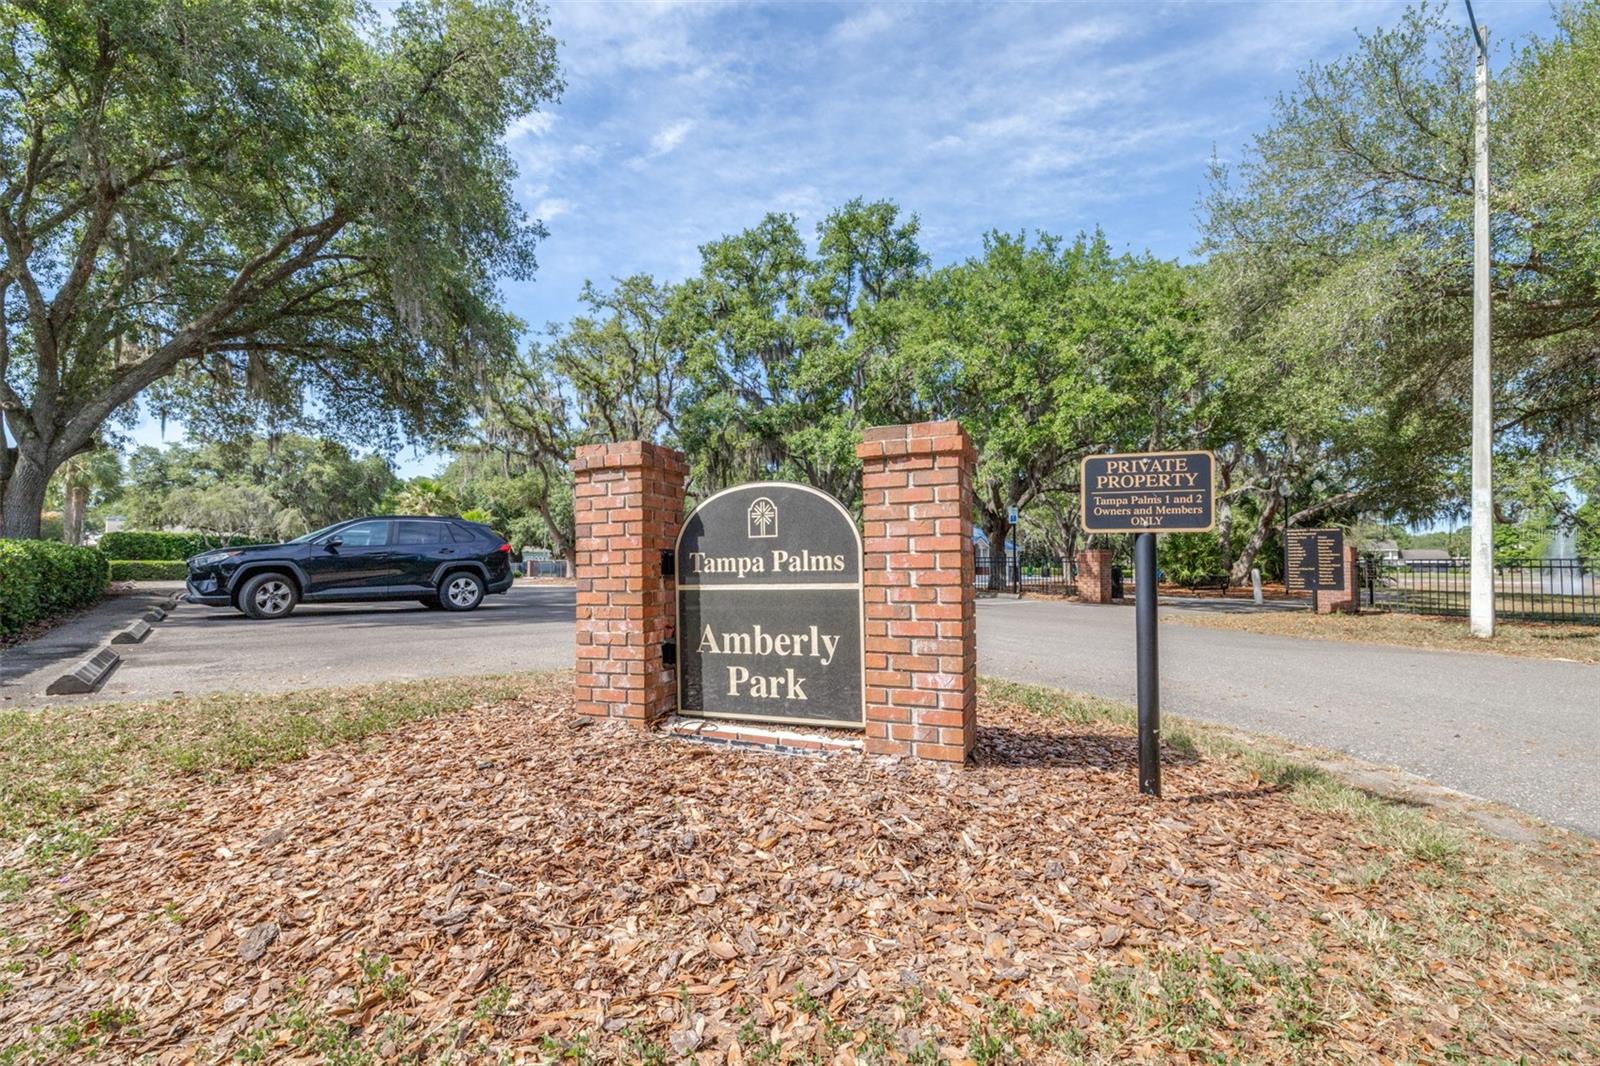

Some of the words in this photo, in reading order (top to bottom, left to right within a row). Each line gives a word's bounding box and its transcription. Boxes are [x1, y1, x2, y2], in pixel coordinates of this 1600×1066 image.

[1106, 458, 1188, 474] PRIVATE
[1096, 473, 1198, 488] PROPERTY
[1094, 497, 1128, 506] Tampa
[1131, 496, 1162, 504] Palms
[1174, 495, 1193, 503] and
[1196, 494, 1202, 503] 2
[1094, 508, 1131, 516] Owners
[1156, 506, 1203, 514] Members
[1131, 516, 1163, 526] ONLY
[689, 552, 765, 578] Tampa
[771, 550, 845, 572] Palms
[697, 624, 840, 665] Amberly
[727, 666, 808, 700] Park
